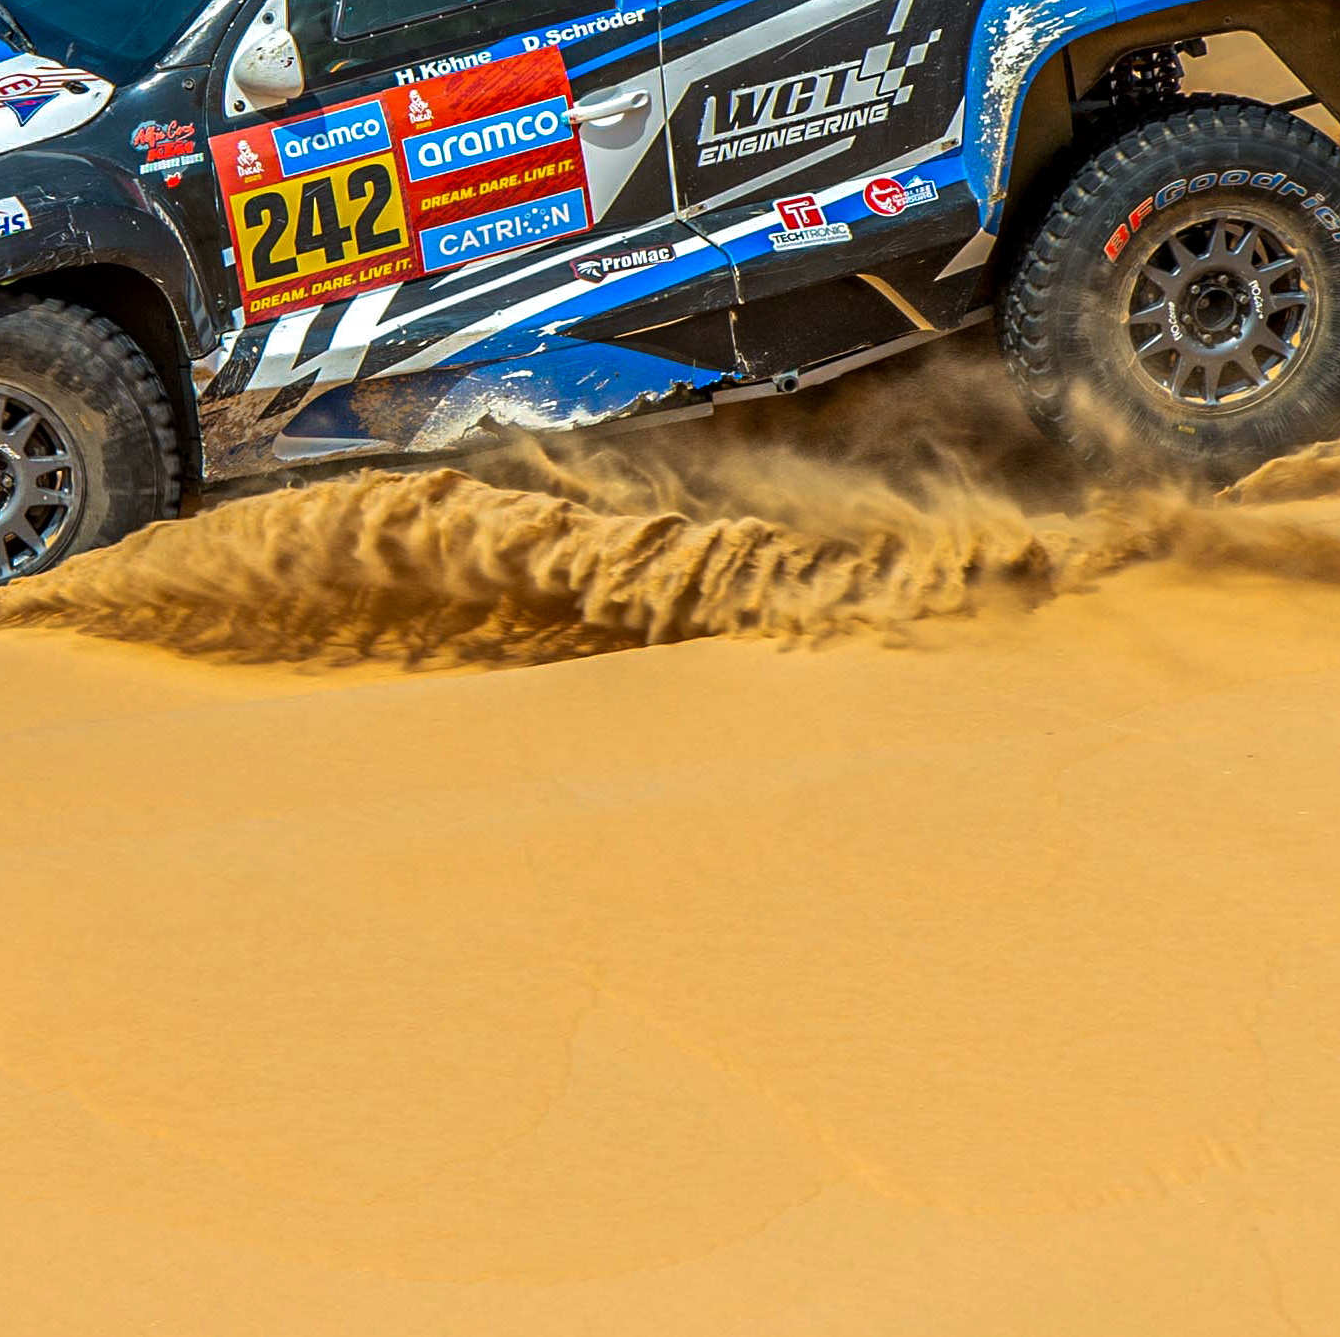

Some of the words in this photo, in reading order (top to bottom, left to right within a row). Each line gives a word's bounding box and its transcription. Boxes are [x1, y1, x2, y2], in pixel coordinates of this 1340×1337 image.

[521, 8, 647, 53] D.Schröder
[395, 50, 492, 86] H.Köhne
[284, 118, 380, 158] aramco
[417, 110, 559, 167] aramco
[697, 102, 890, 167] ENGINEERING
[421, 187, 476, 211] DREAM.
[479, 174, 521, 195] DARE.
[524, 163, 555, 183] LIVE
[558, 159, 575, 172] IT.
[243, 163, 402, 284] 242
[773, 224, 848, 244] TECHTRONIC
[601, 247, 670, 272] ProMac
[249, 287, 308, 312] DREAM.
[311, 275, 357, 296] DARE.
[359, 263, 392, 282] LIVE
[395, 257, 413, 271] IT.
